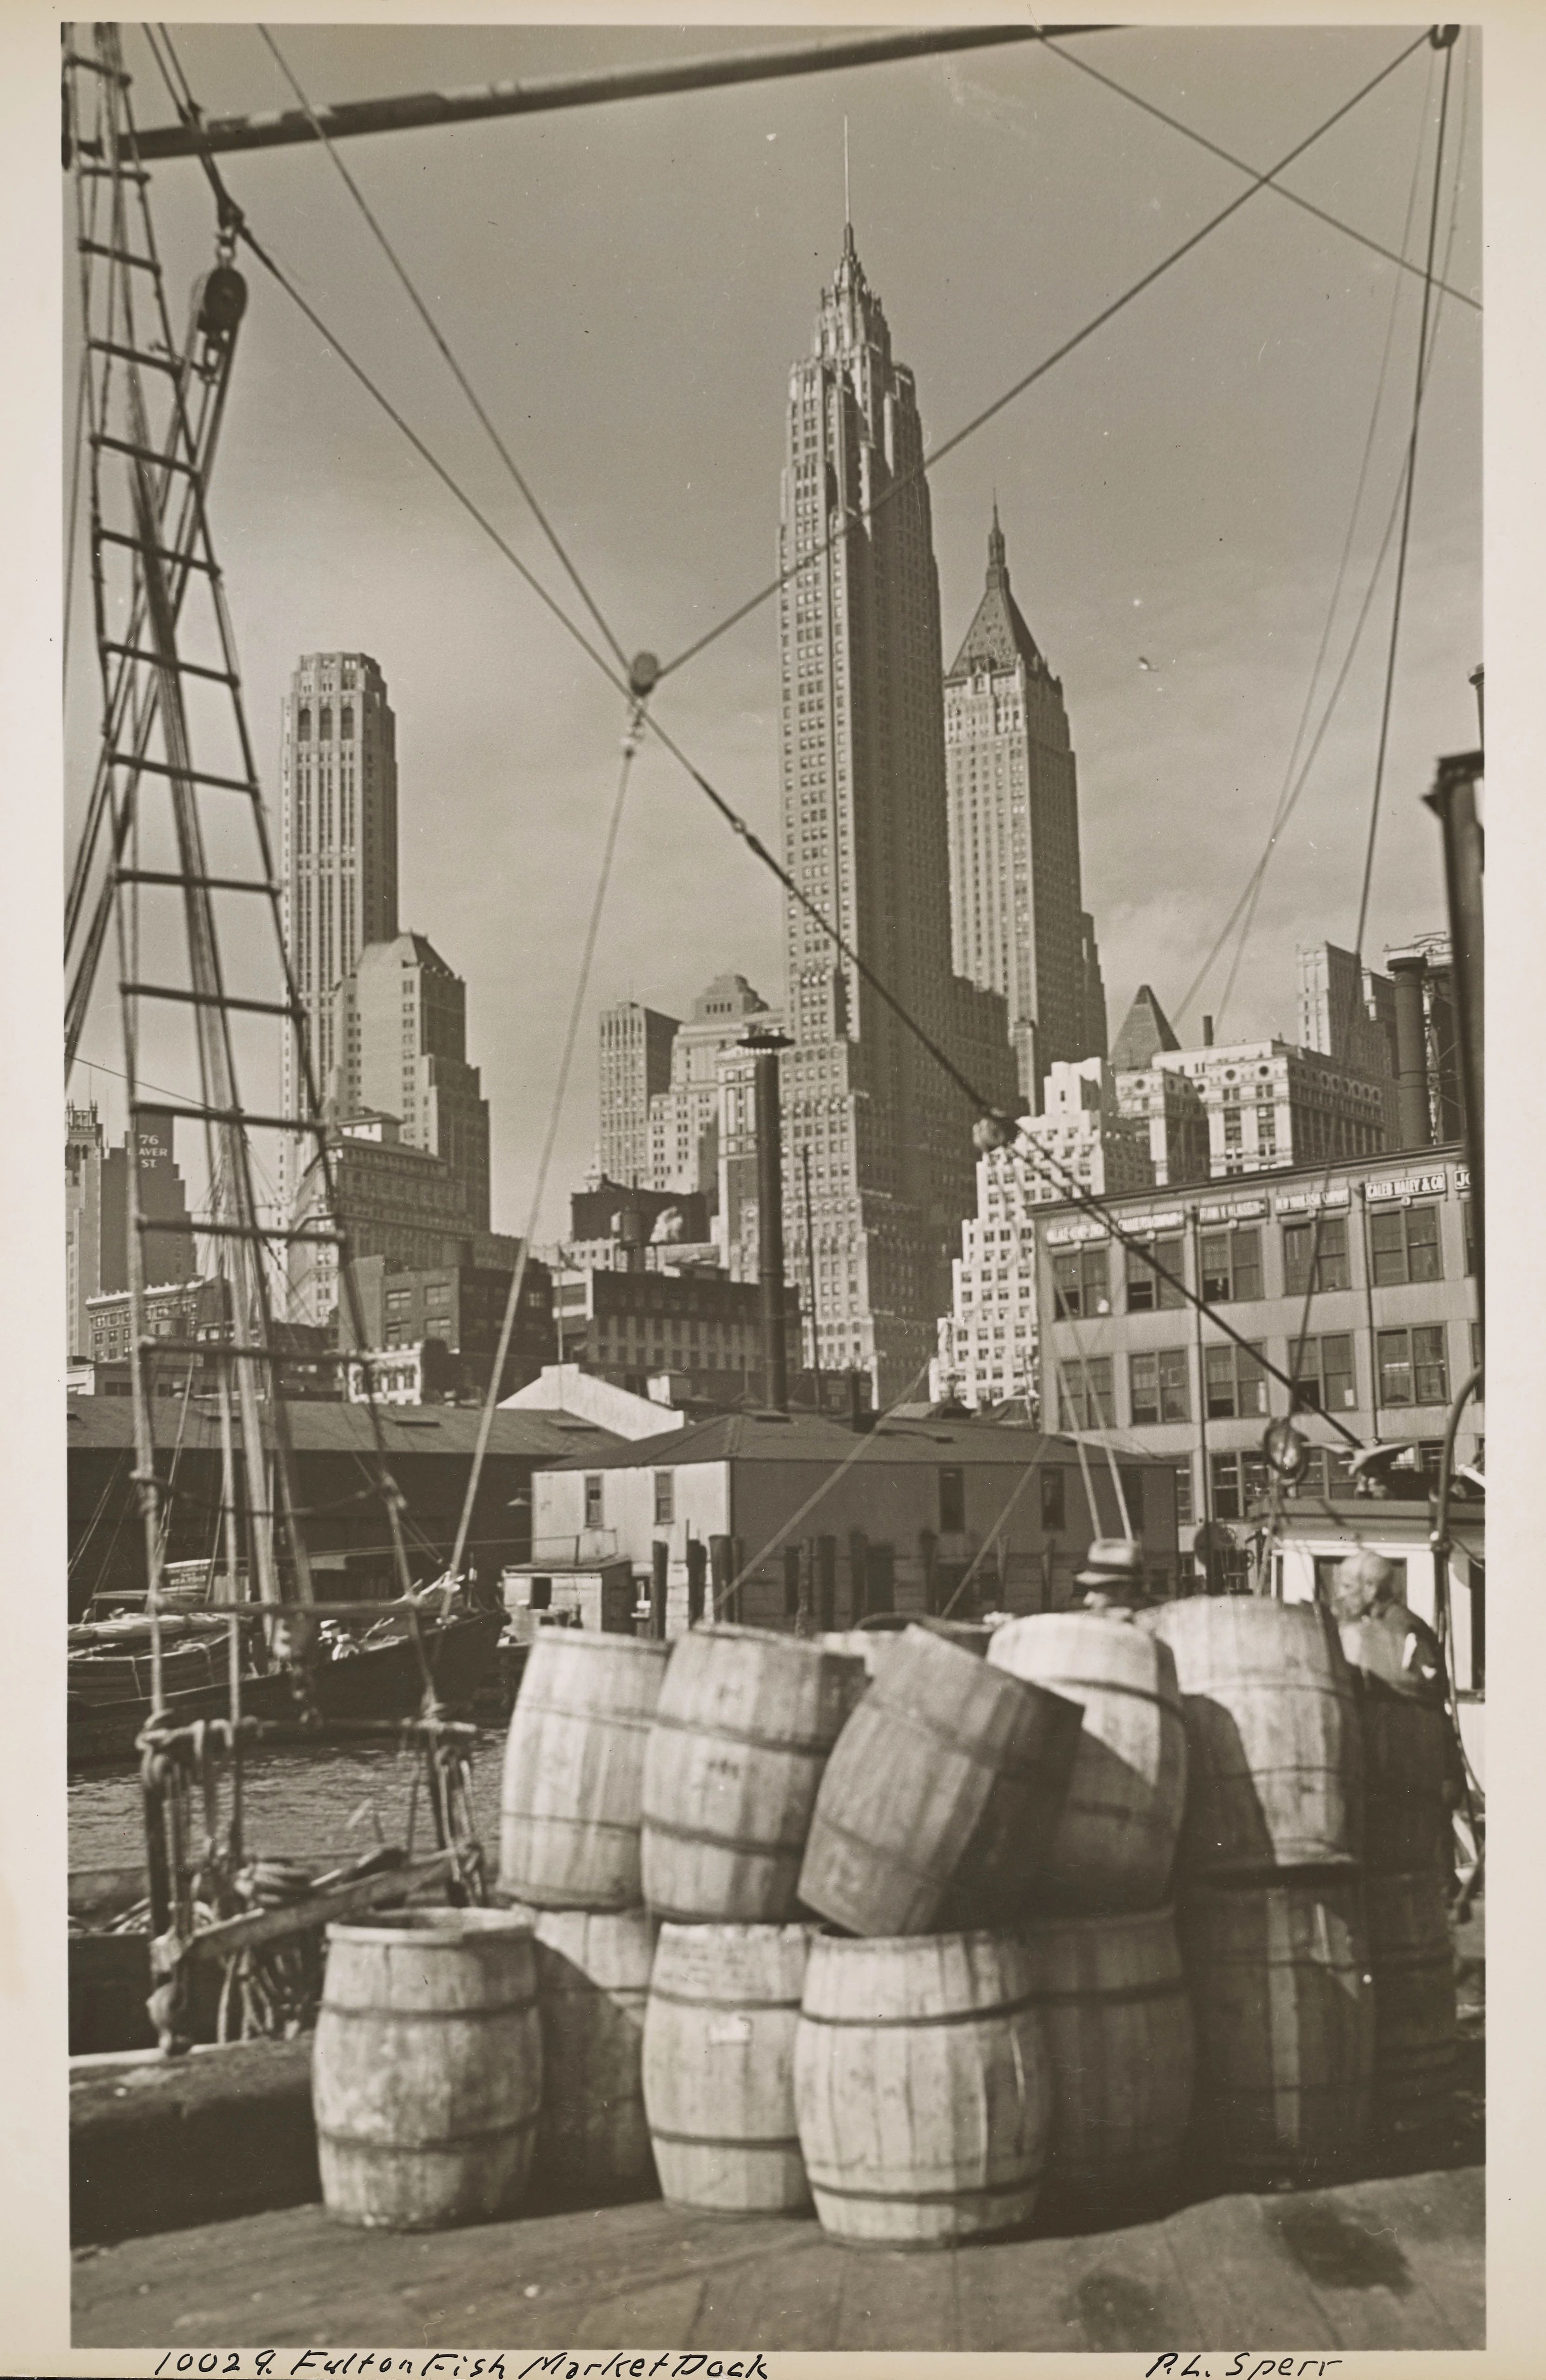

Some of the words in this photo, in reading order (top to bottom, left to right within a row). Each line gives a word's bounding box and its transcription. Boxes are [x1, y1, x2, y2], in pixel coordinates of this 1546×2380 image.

[139, 1135, 159, 1145] 76
[127, 1148, 167, 1157] AVER
[1367, 1183, 1393, 1198] CALEB
[1394, 1178, 1420, 1194] HALEY
[1421, 1177, 1430, 1191] &
